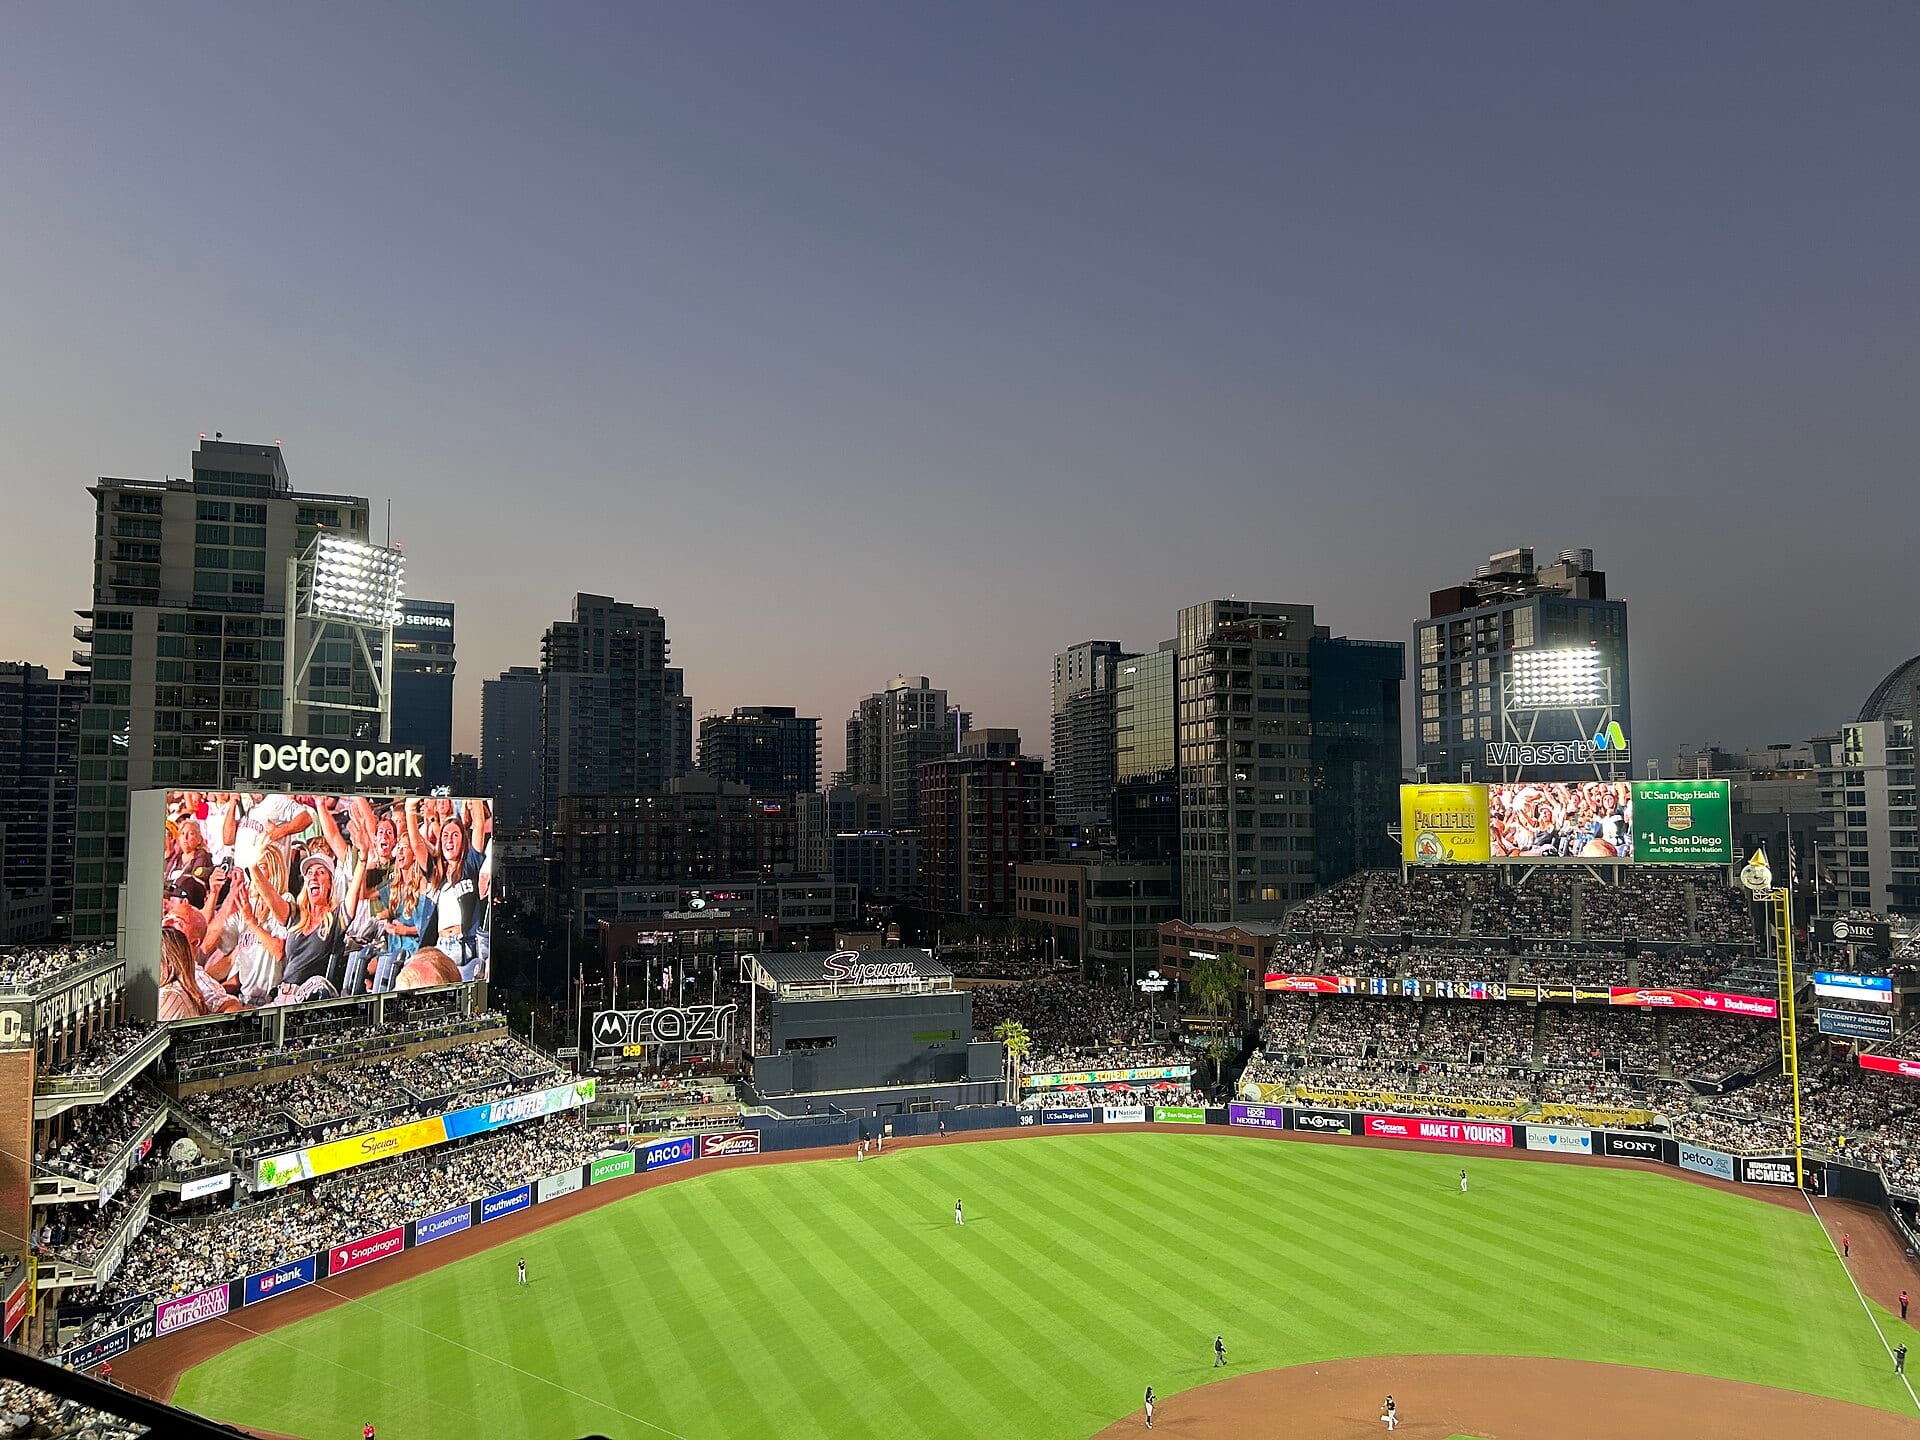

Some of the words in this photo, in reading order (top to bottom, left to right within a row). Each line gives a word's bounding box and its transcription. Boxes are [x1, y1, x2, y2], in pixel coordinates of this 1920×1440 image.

[406, 615, 451, 627] SEMPRA
[253, 740, 350, 779] petco
[355, 750, 422, 783] park
[1490, 740, 1587, 766] Viasat
[1640, 791, 1653, 800] UC
[1654, 791, 1669, 800] San
[1670, 791, 1693, 801] Diego
[1693, 790, 1720, 799] Health
[1659, 835, 1668, 845] in
[1670, 836, 1689, 845] San
[1691, 835, 1722, 846] Diego
[1661, 846, 1673, 854] Top
[1849, 926, 1874, 936] MRC
[823, 951, 917, 986] Sycuan
[72, 980, 92, 1012] METAL
[94, 966, 116, 999] SUPPLY
[1285, 977, 1317, 990] Sycuan
[1635, 990, 1672, 1004] Sycuan
[1724, 998, 1773, 1014] Budweiser
[631, 1004, 738, 1044] razr
[1306, 1087, 1349, 1097] CHROME
[1352, 1091, 1381, 1099] TOUR
[1437, 1097, 1463, 1105] GOLD
[1020, 1115, 1034, 1126] 396
[1420, 1123, 1448, 1137] MAKE
[1450, 1126, 1459, 1138] IT
[1459, 1126, 1506, 1143] YOURS!
[1528, 1133, 1548, 1142] blue
[1560, 1136, 1580, 1144] blue
[361, 1136, 399, 1155] Sycuan
[704, 1135, 754, 1155] Sycuan
[1612, 1139, 1657, 1152] SONY
[647, 1145, 681, 1165] ARCO
[1682, 1149, 1714, 1167] petco
[1746, 1167, 1796, 1183] HOMERS
[1748, 1161, 1776, 1171] HUNGRY
[1777, 1164, 1791, 1172] FOR
[484, 1196, 523, 1215] Southwest
[351, 1236, 400, 1260] Snapdragon
[160, 1299, 225, 1330] CALIFORNIA
[133, 1321, 153, 1343] 342
